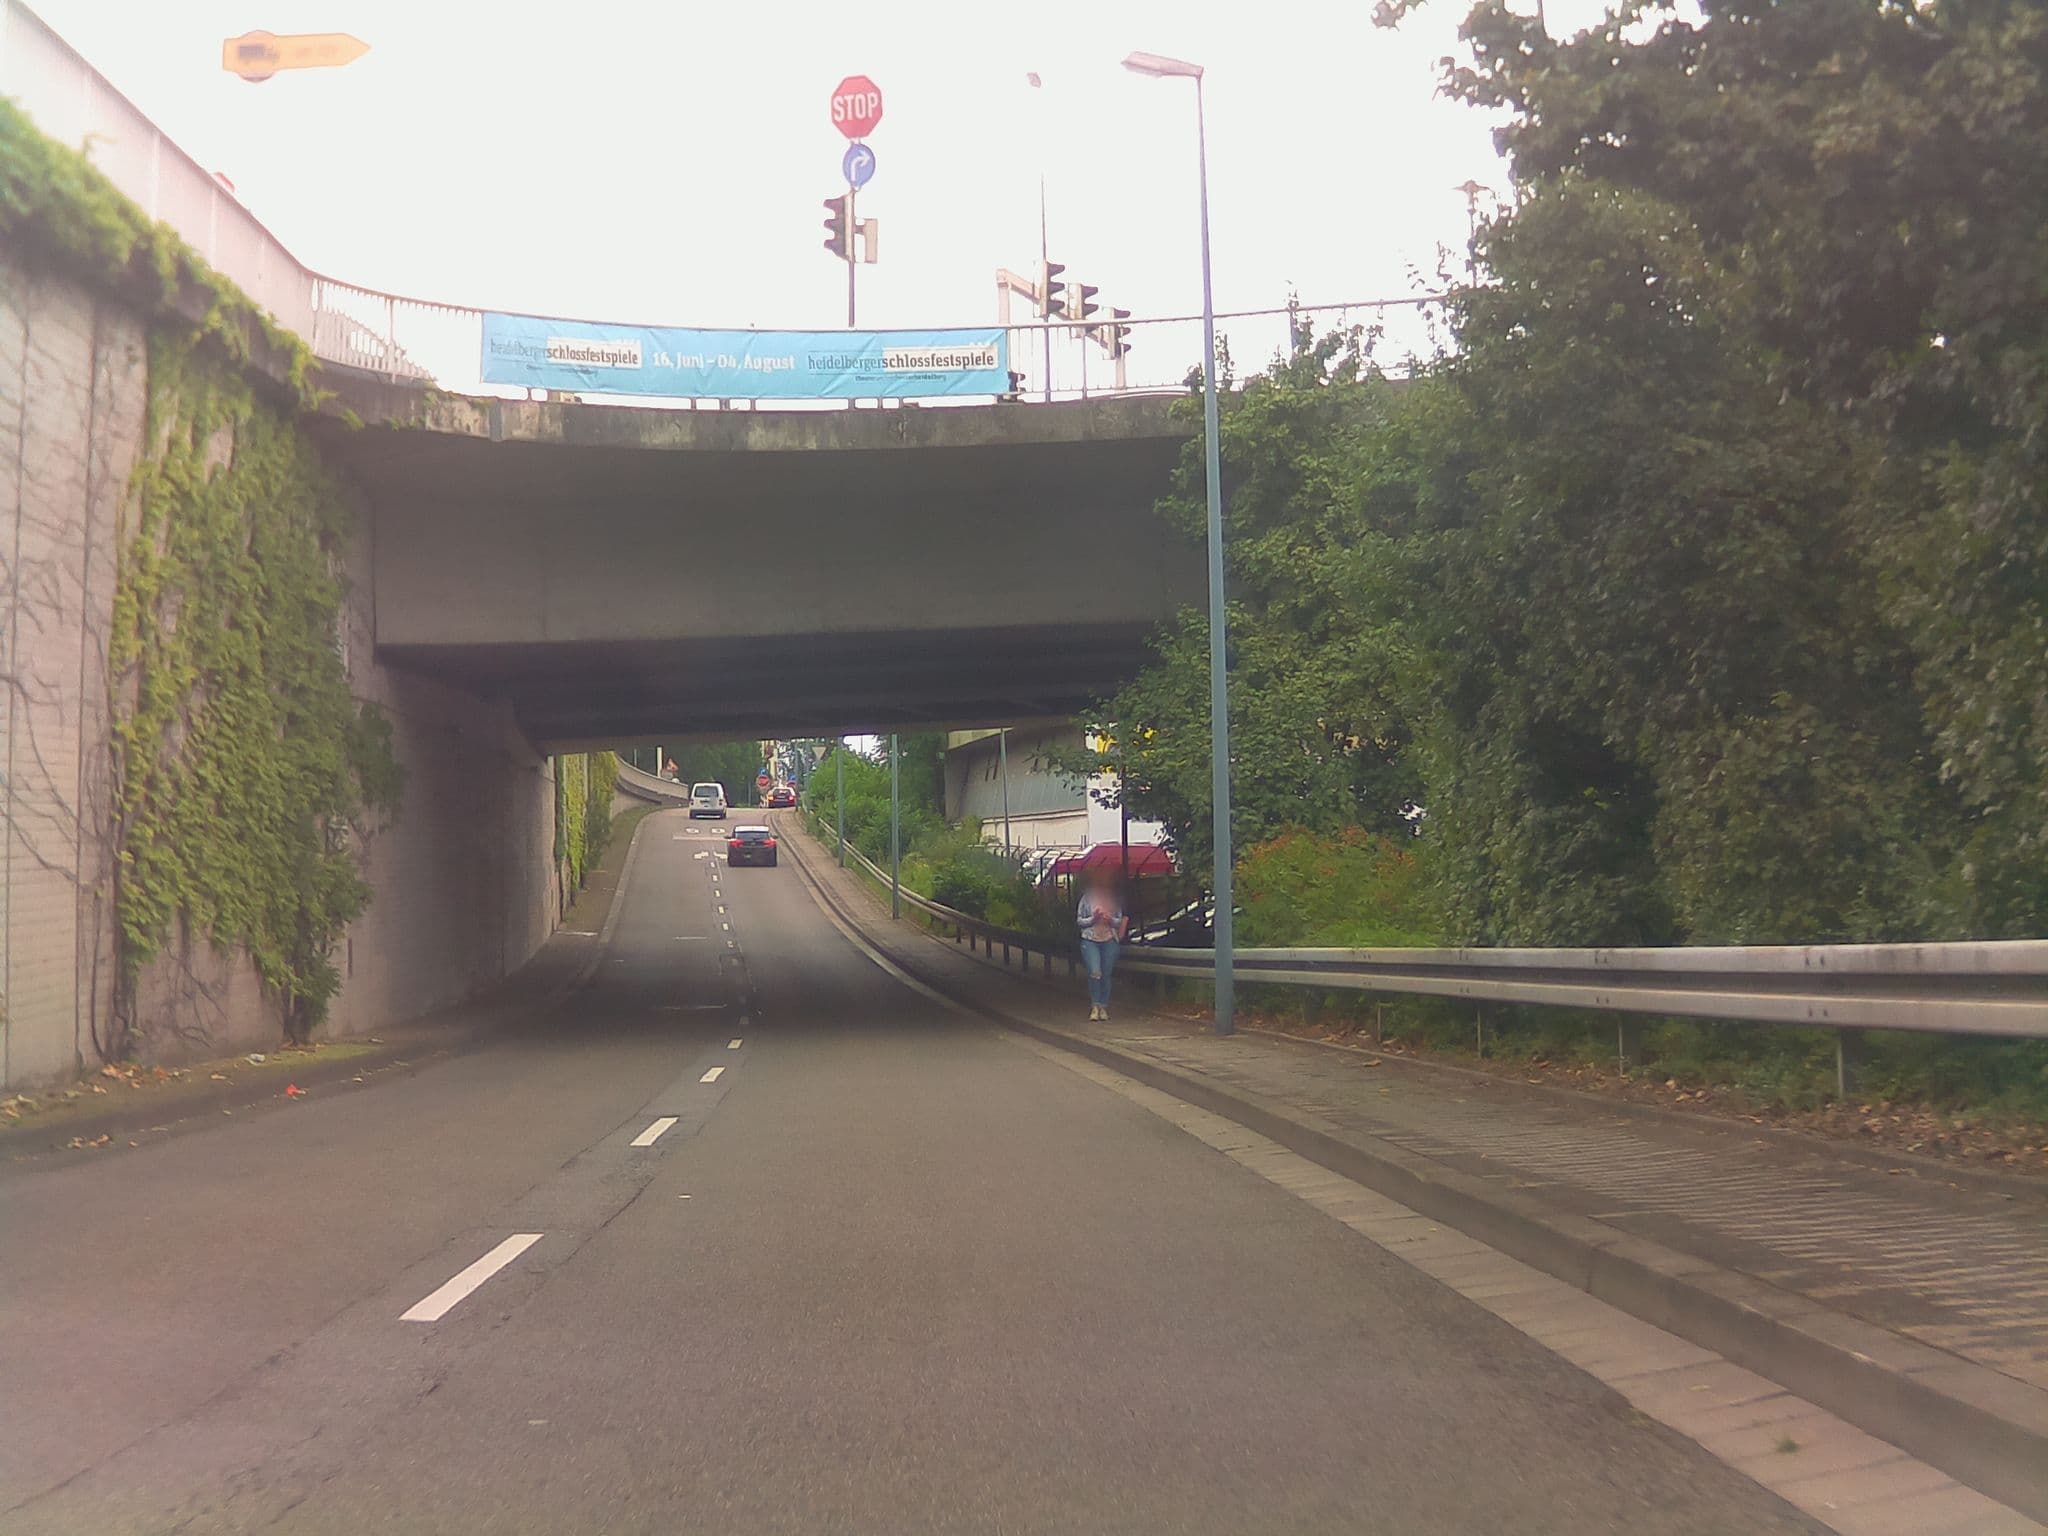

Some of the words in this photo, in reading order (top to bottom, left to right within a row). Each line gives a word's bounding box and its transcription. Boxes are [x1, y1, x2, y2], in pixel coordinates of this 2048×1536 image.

[833, 92, 879, 122] STOP
[675, 351, 704, 370] Juni
[743, 352, 796, 374] August
